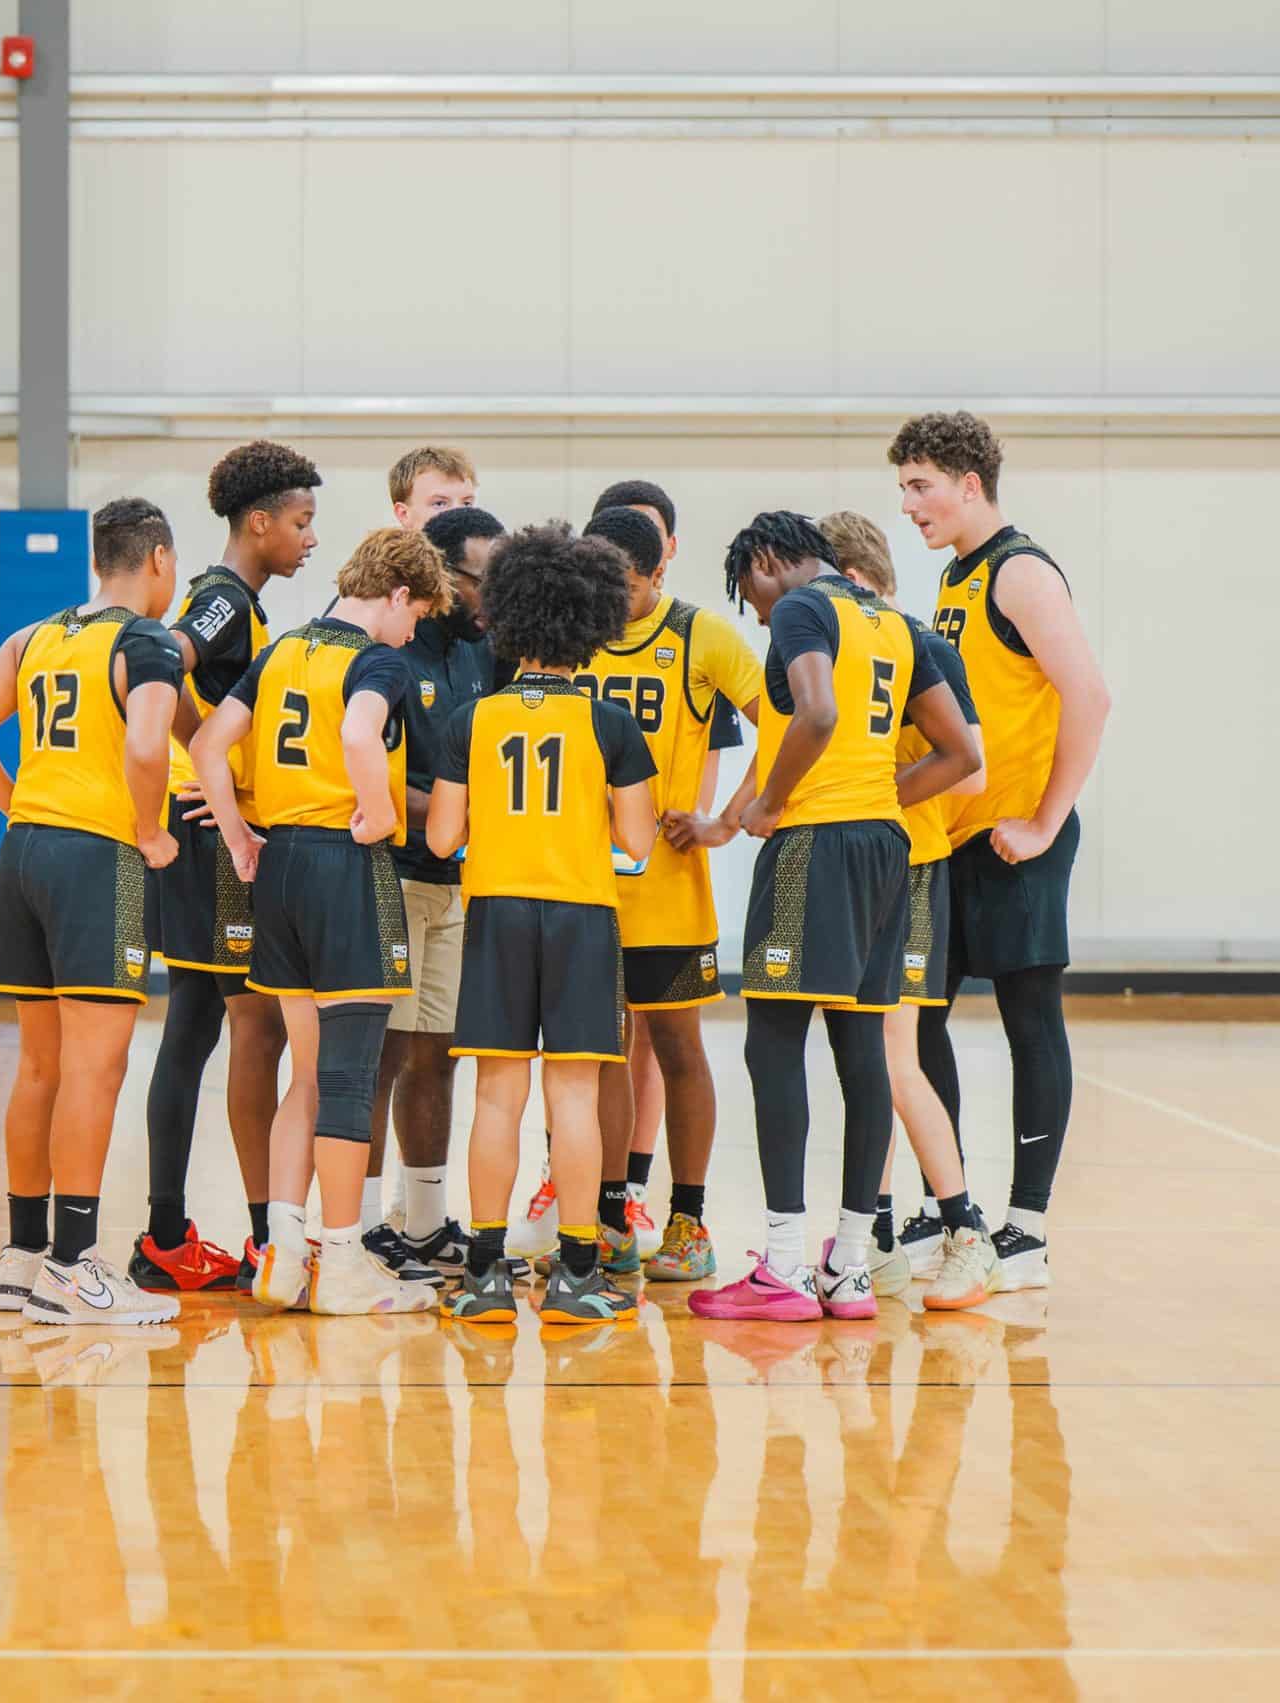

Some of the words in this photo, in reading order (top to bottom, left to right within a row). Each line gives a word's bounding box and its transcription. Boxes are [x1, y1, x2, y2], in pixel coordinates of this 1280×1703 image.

[28, 670, 81, 752] 12
[274, 687, 312, 770] 2
[868, 656, 896, 738] 5
[496, 731, 565, 816] 11
